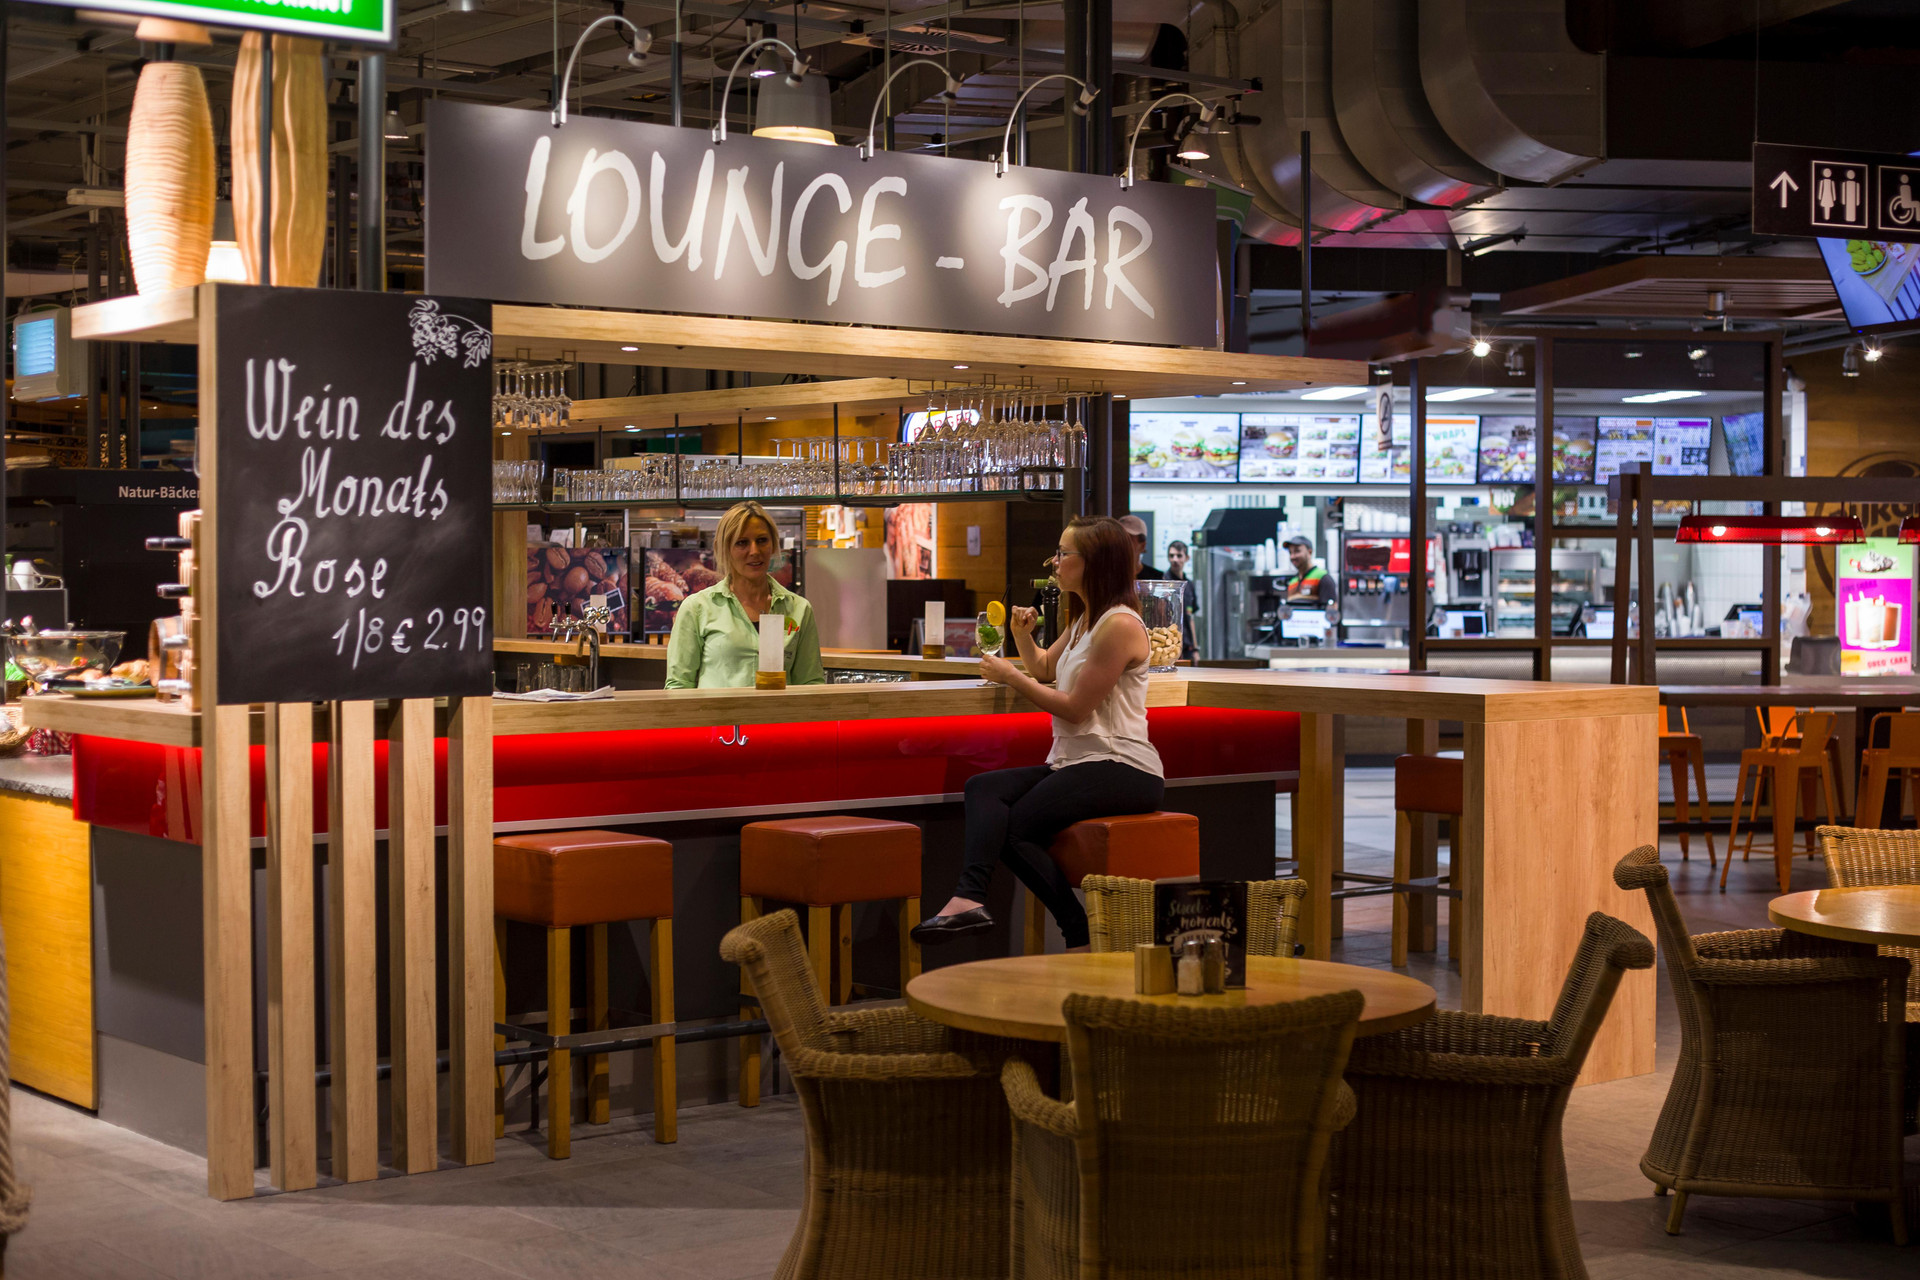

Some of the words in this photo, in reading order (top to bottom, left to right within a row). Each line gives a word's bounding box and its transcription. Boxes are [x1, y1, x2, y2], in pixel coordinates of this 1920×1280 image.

[521, 136, 908, 305] LOUNGE
[936, 256, 964, 269] -
[997, 194, 1155, 320] BAR
[246, 358, 360, 441] Wein
[380, 361, 456, 445] des
[277, 446, 448, 520] Monats
[253, 517, 388, 599] Rose
[332, 607, 384, 670] 1/8
[423, 605, 486, 652] 2.99
